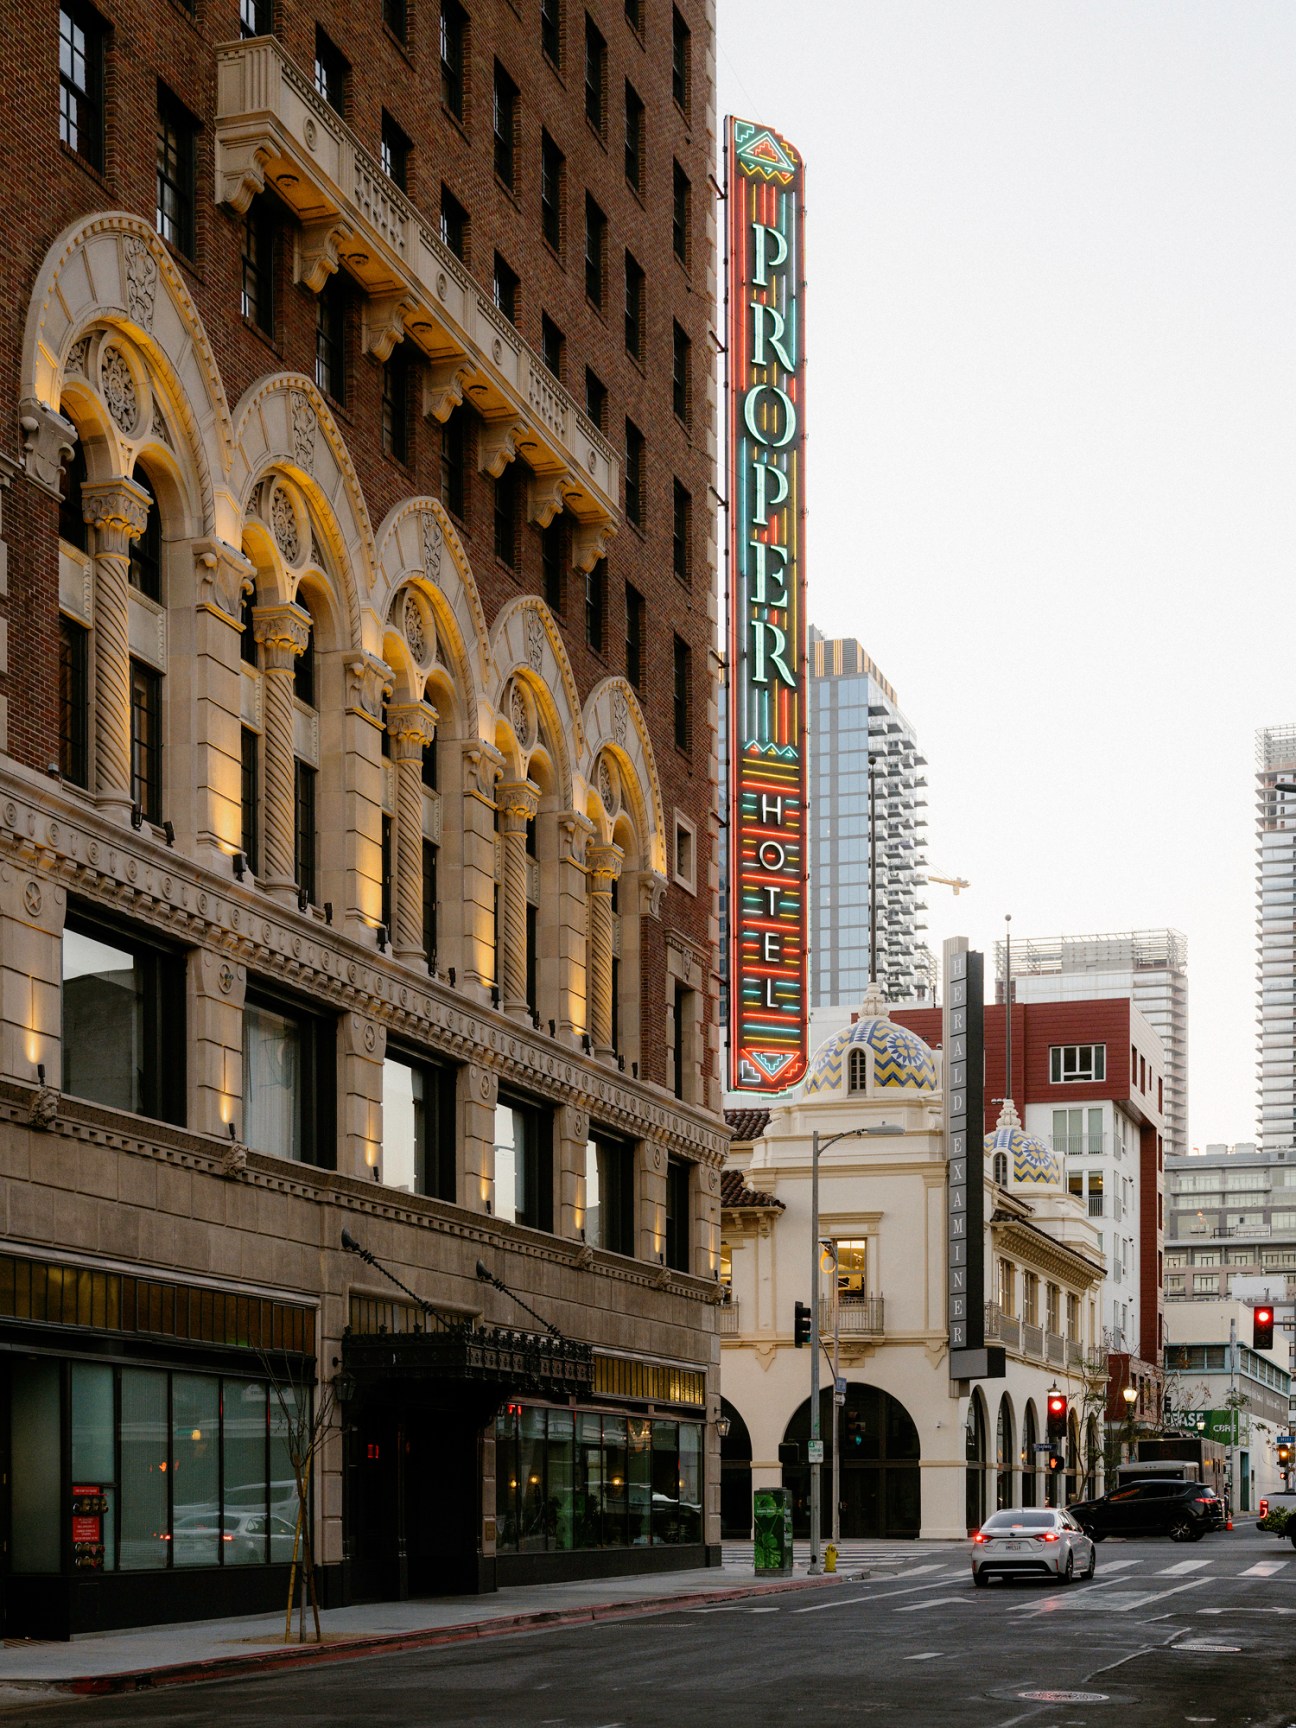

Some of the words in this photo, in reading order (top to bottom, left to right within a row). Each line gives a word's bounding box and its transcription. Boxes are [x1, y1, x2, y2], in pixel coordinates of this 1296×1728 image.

[744, 223, 797, 687] PROPER
[758, 793, 785, 1009] HOTEL
[953, 958, 963, 1112] HERALD
[953, 1137, 963, 1343] EXAMINER
[1212, 1424, 1237, 1432] CBRE
